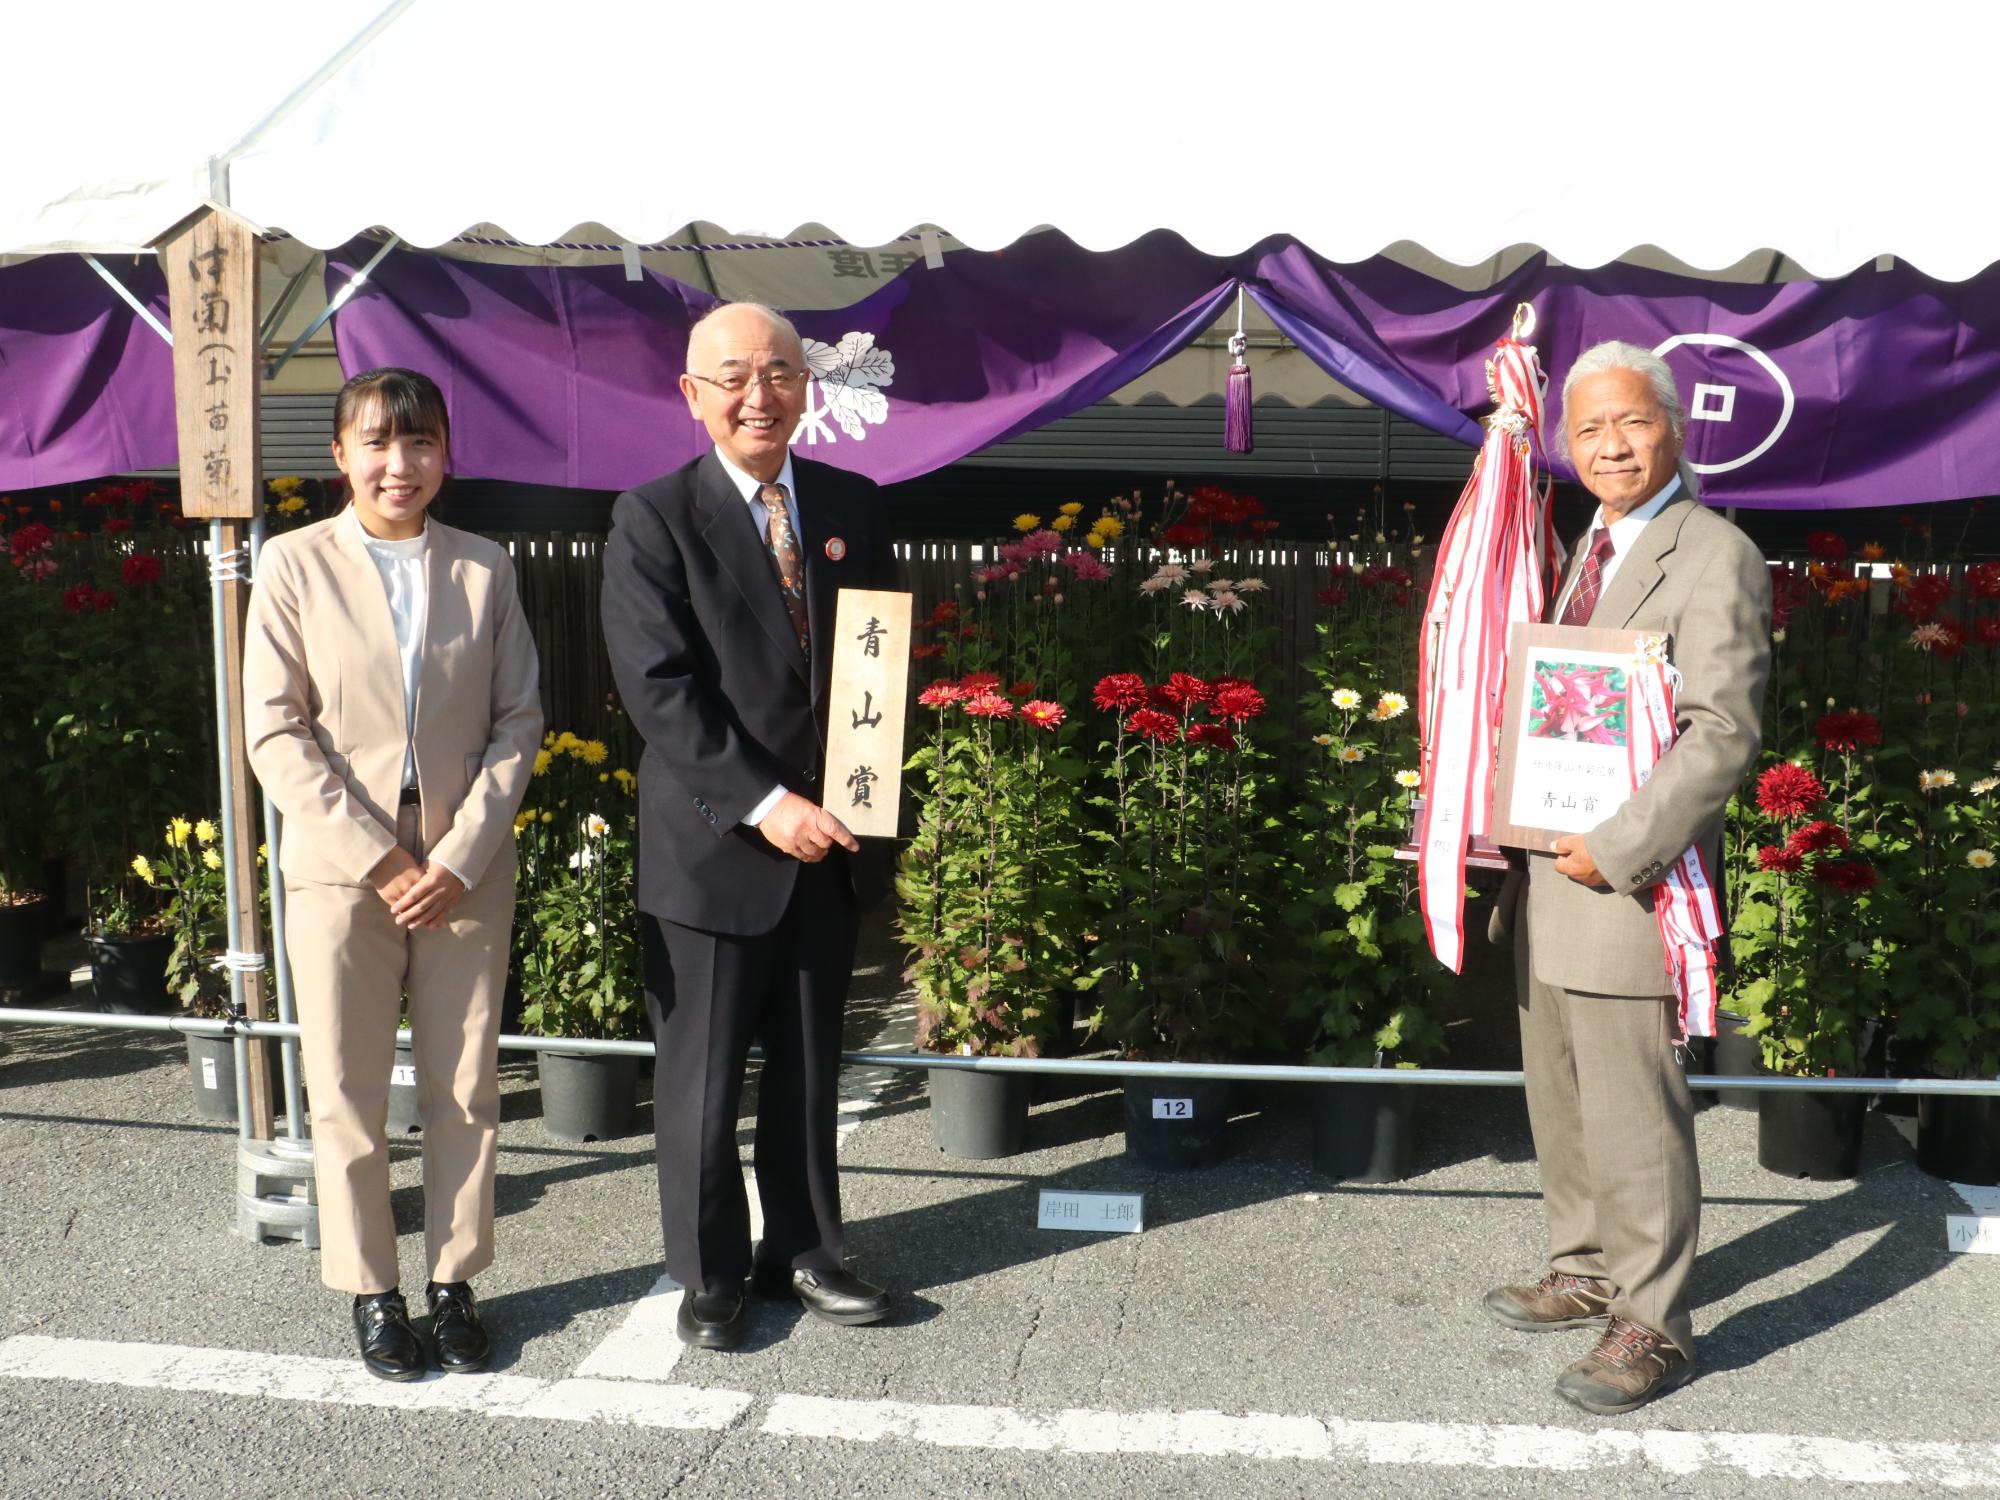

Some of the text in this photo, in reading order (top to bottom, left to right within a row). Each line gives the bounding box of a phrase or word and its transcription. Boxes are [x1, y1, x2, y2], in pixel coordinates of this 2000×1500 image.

[847, 616, 888, 809] 青山賞
[1541, 791, 1599, 814] 青山賞
[1163, 1101, 1186, 1116] 12
[1044, 1200, 1080, 1219] 岸田
[1955, 1224, 1993, 1243] 小林
